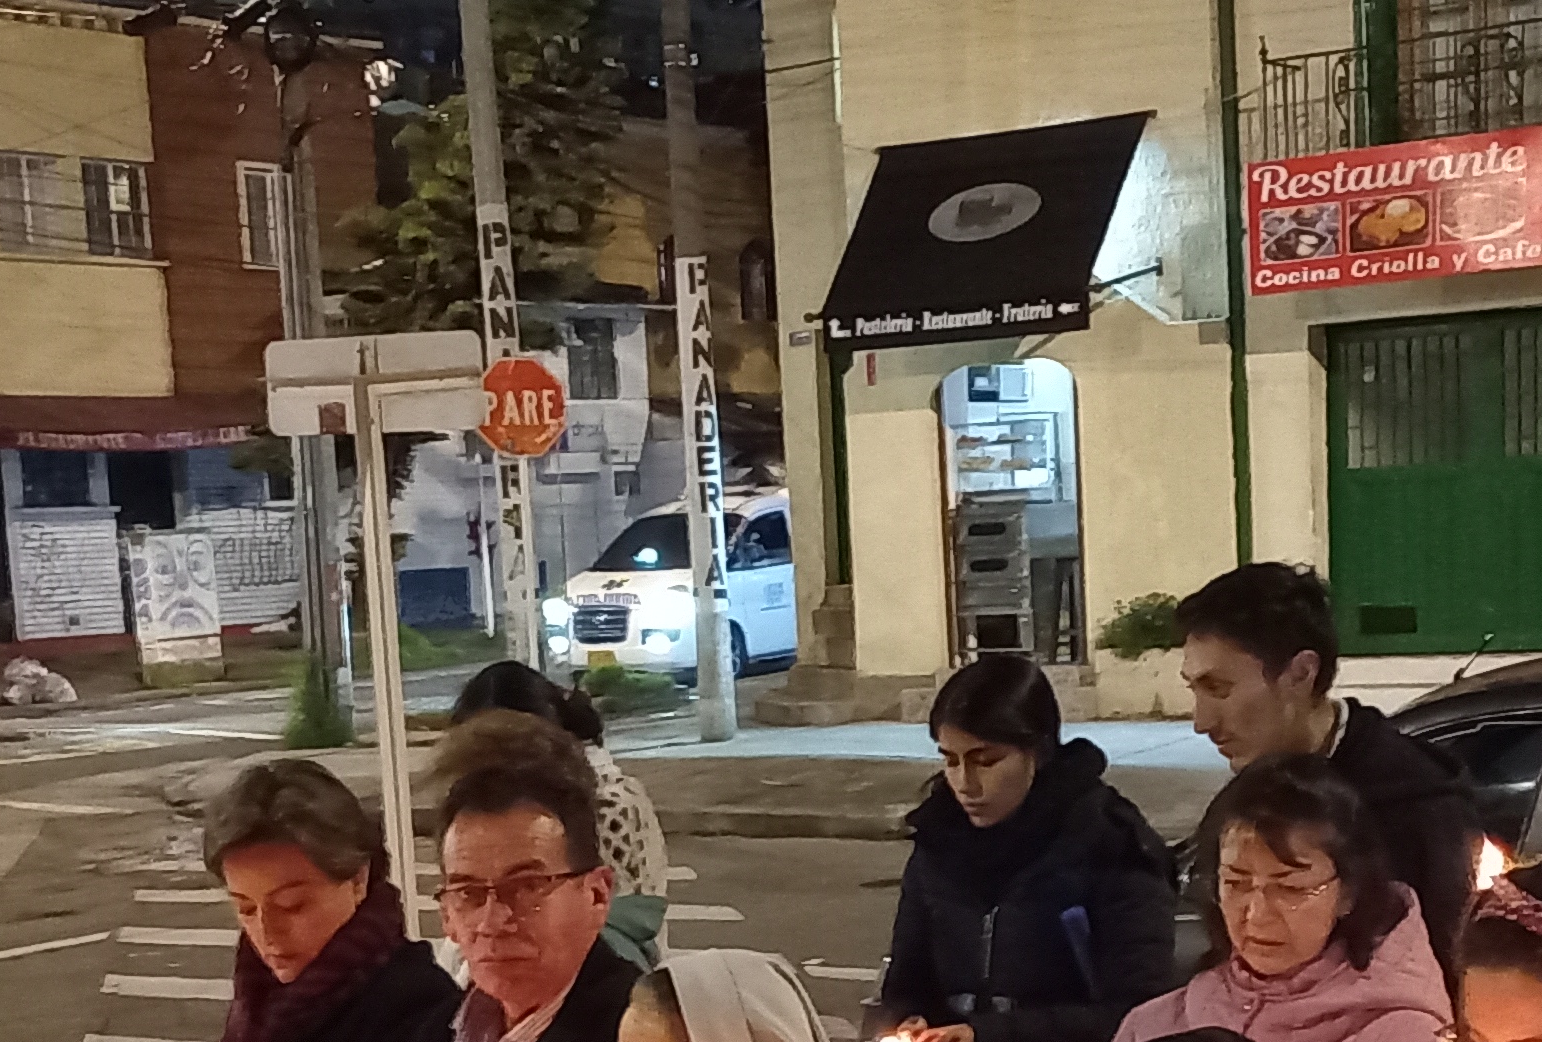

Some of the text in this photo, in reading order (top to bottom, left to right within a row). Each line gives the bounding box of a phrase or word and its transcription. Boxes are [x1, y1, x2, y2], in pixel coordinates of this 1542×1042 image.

[1252, 141, 1526, 203] Restaurante
[1255, 264, 1340, 288] Cocina
[1350, 251, 1440, 278] Criolla
[1452, 252, 1468, 273] y
[483, 389, 556, 428] PARE
[687, 262, 725, 587] PANADERIA
